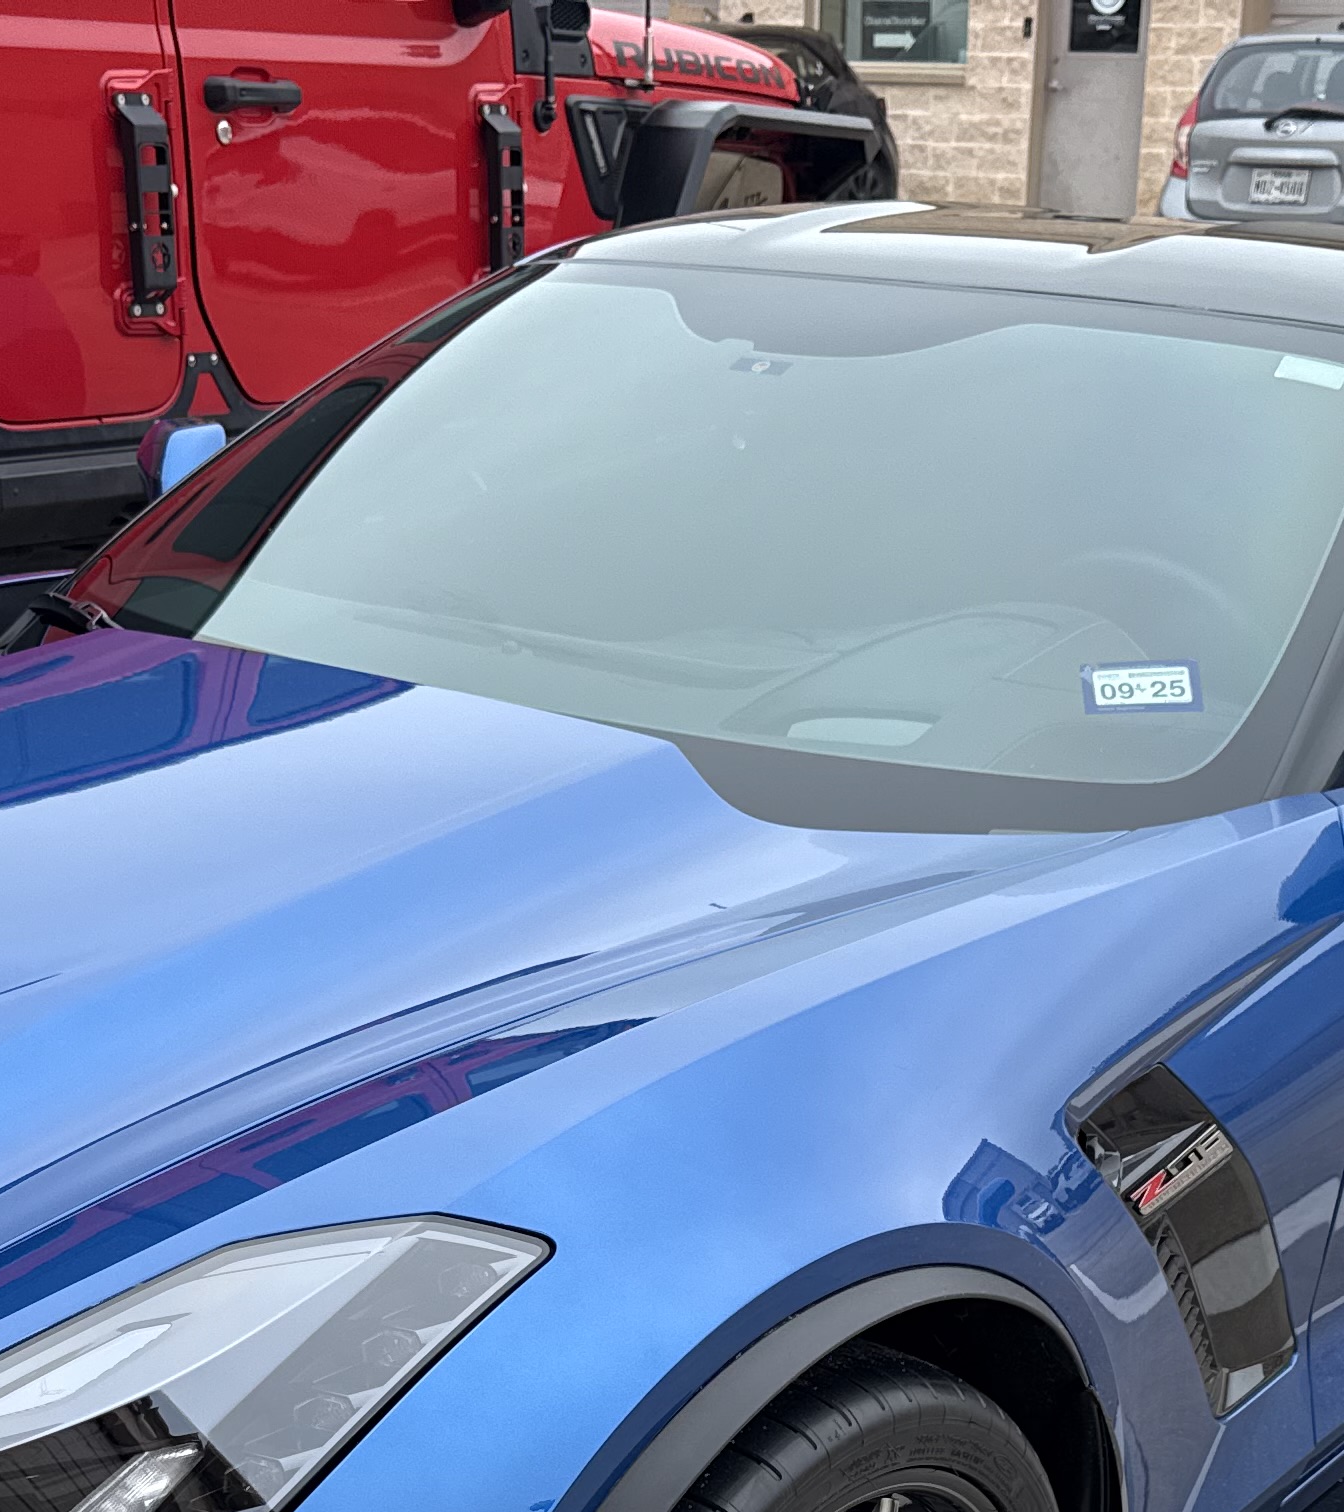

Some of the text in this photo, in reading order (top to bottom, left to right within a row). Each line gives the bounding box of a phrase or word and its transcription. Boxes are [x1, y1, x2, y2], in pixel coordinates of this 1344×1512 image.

[613, 40, 786, 89] RUBICON
[1100, 679, 1186, 701] 09 25
